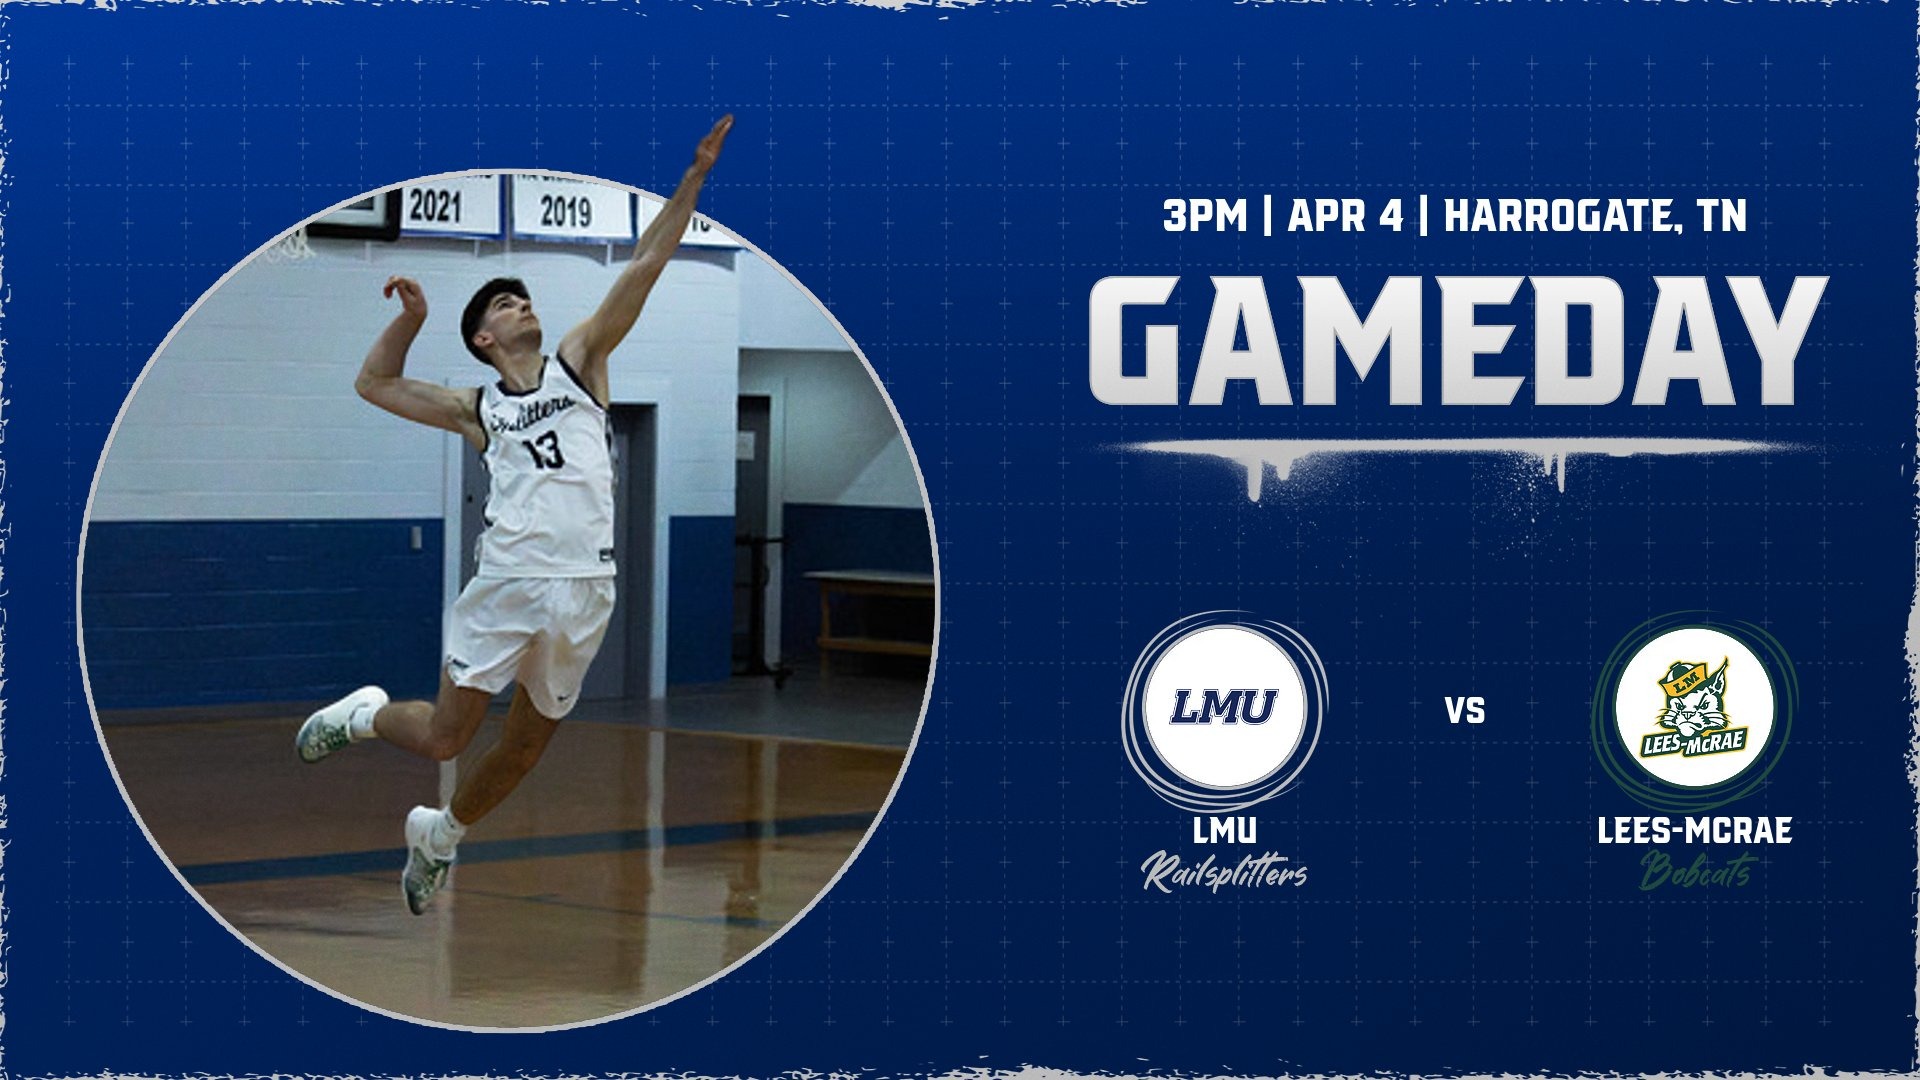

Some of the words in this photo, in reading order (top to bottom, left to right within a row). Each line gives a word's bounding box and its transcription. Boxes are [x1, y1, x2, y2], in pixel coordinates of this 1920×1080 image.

[410, 188, 460, 223] 2021
[541, 194, 592, 227] 2019
[522, 430, 565, 470] 13
